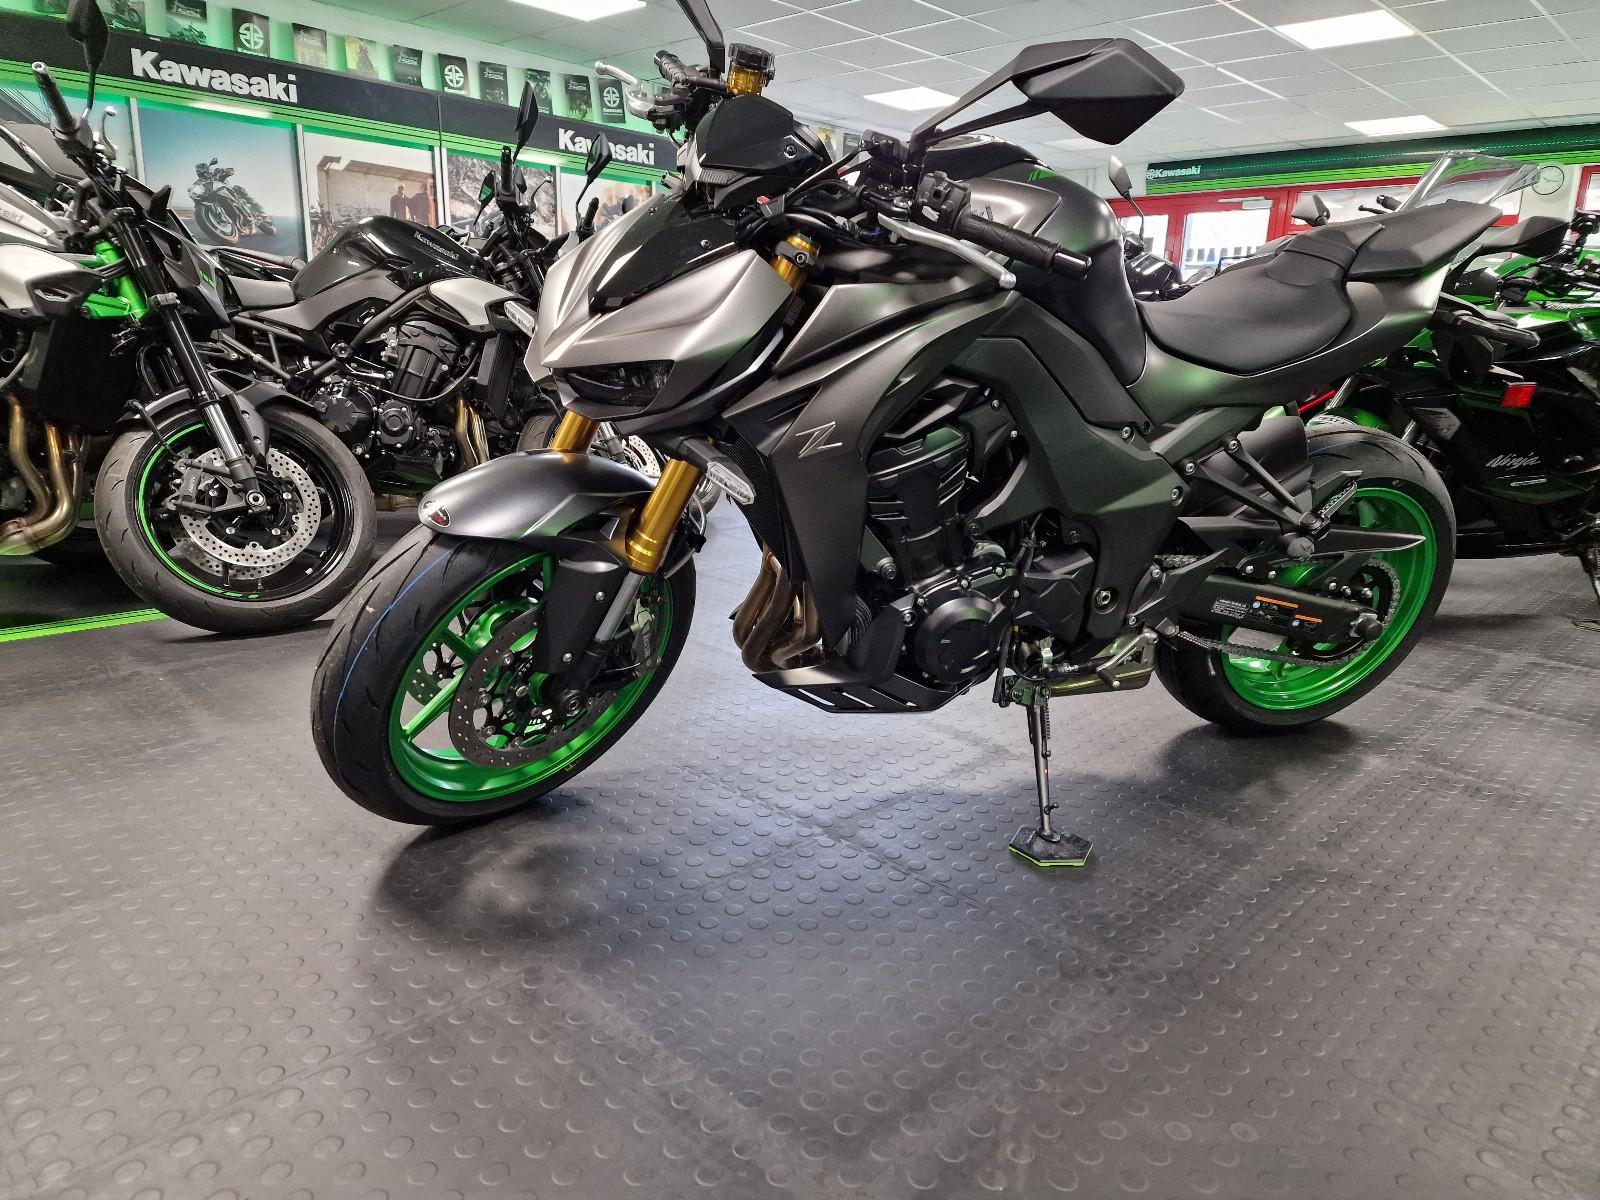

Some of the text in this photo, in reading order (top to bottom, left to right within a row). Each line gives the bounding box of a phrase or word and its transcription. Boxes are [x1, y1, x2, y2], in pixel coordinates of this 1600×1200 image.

[131, 48, 298, 103] Kawasaki
[1155, 165, 1201, 178] Kawasaki
[1484, 452, 1542, 471] Ninja
